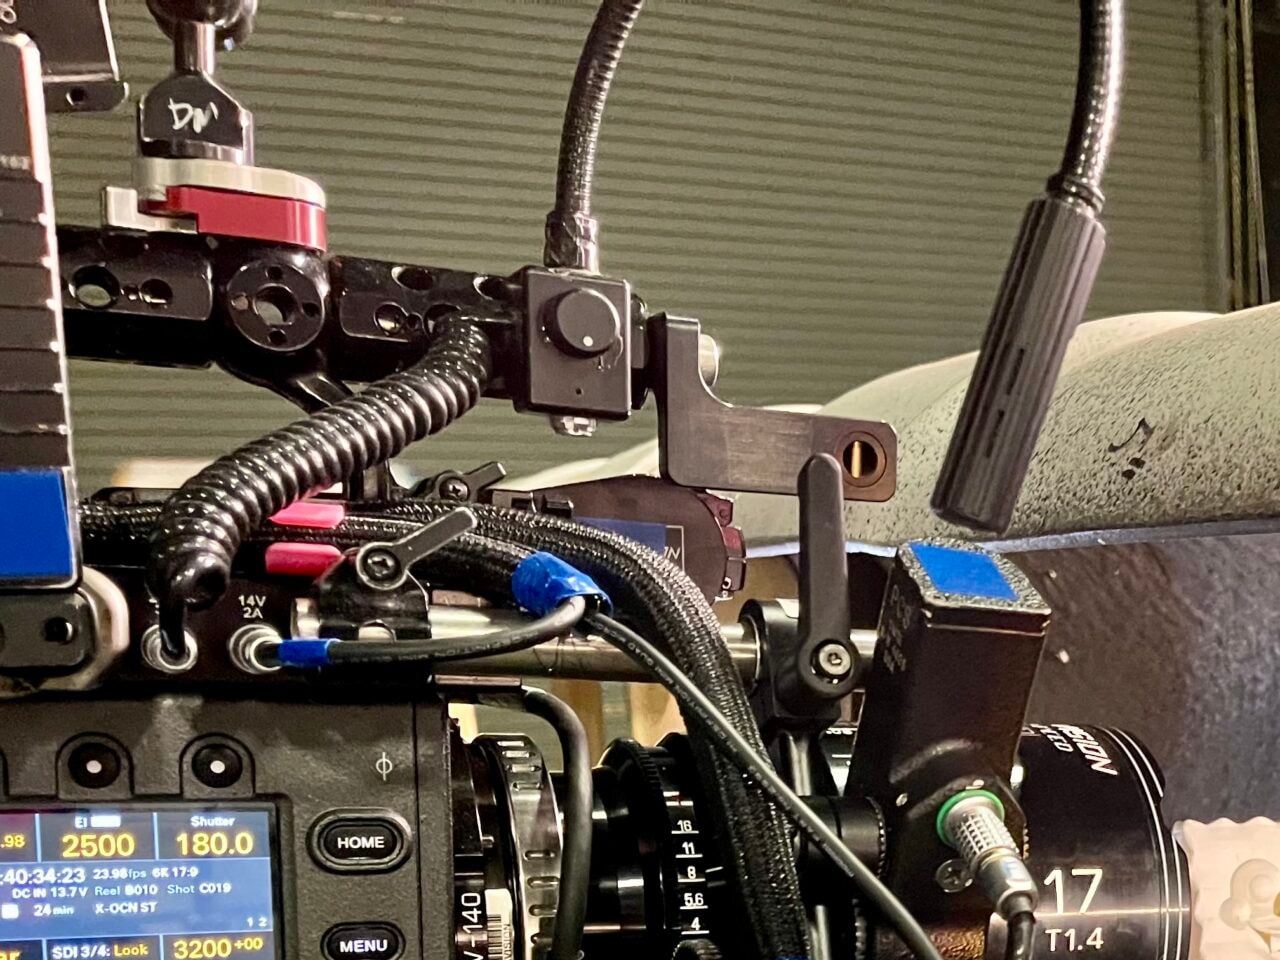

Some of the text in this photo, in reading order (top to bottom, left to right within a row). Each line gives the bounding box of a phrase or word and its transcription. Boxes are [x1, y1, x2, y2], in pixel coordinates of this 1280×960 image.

[239, 595, 267, 607] 14V
[243, 606, 263, 619] 2A
[74, 816, 88, 829] EI
[190, 815, 235, 828] Shutter
[677, 819, 693, 832] 16
[62, 832, 135, 858] 2500
[176, 831, 254, 856] 180.0
[337, 836, 385, 849] HOME
[681, 841, 696, 854] 11
[687, 866, 697, 879] 8
[12, 887, 31, 899] DC
[94, 885, 121, 896] Reel
[167, 884, 195, 895] Shot
[199, 882, 232, 894] C019
[1043, 868, 1103, 914] 17
[140, 901, 158, 913] ST
[690, 917, 701, 931] 4
[1044, 926, 1105, 952] T1.4
[52, 943, 149, 960] SDI 3/4: Look
[173, 937, 264, 960] 3200 +00
[339, 939, 388, 953] MENU
